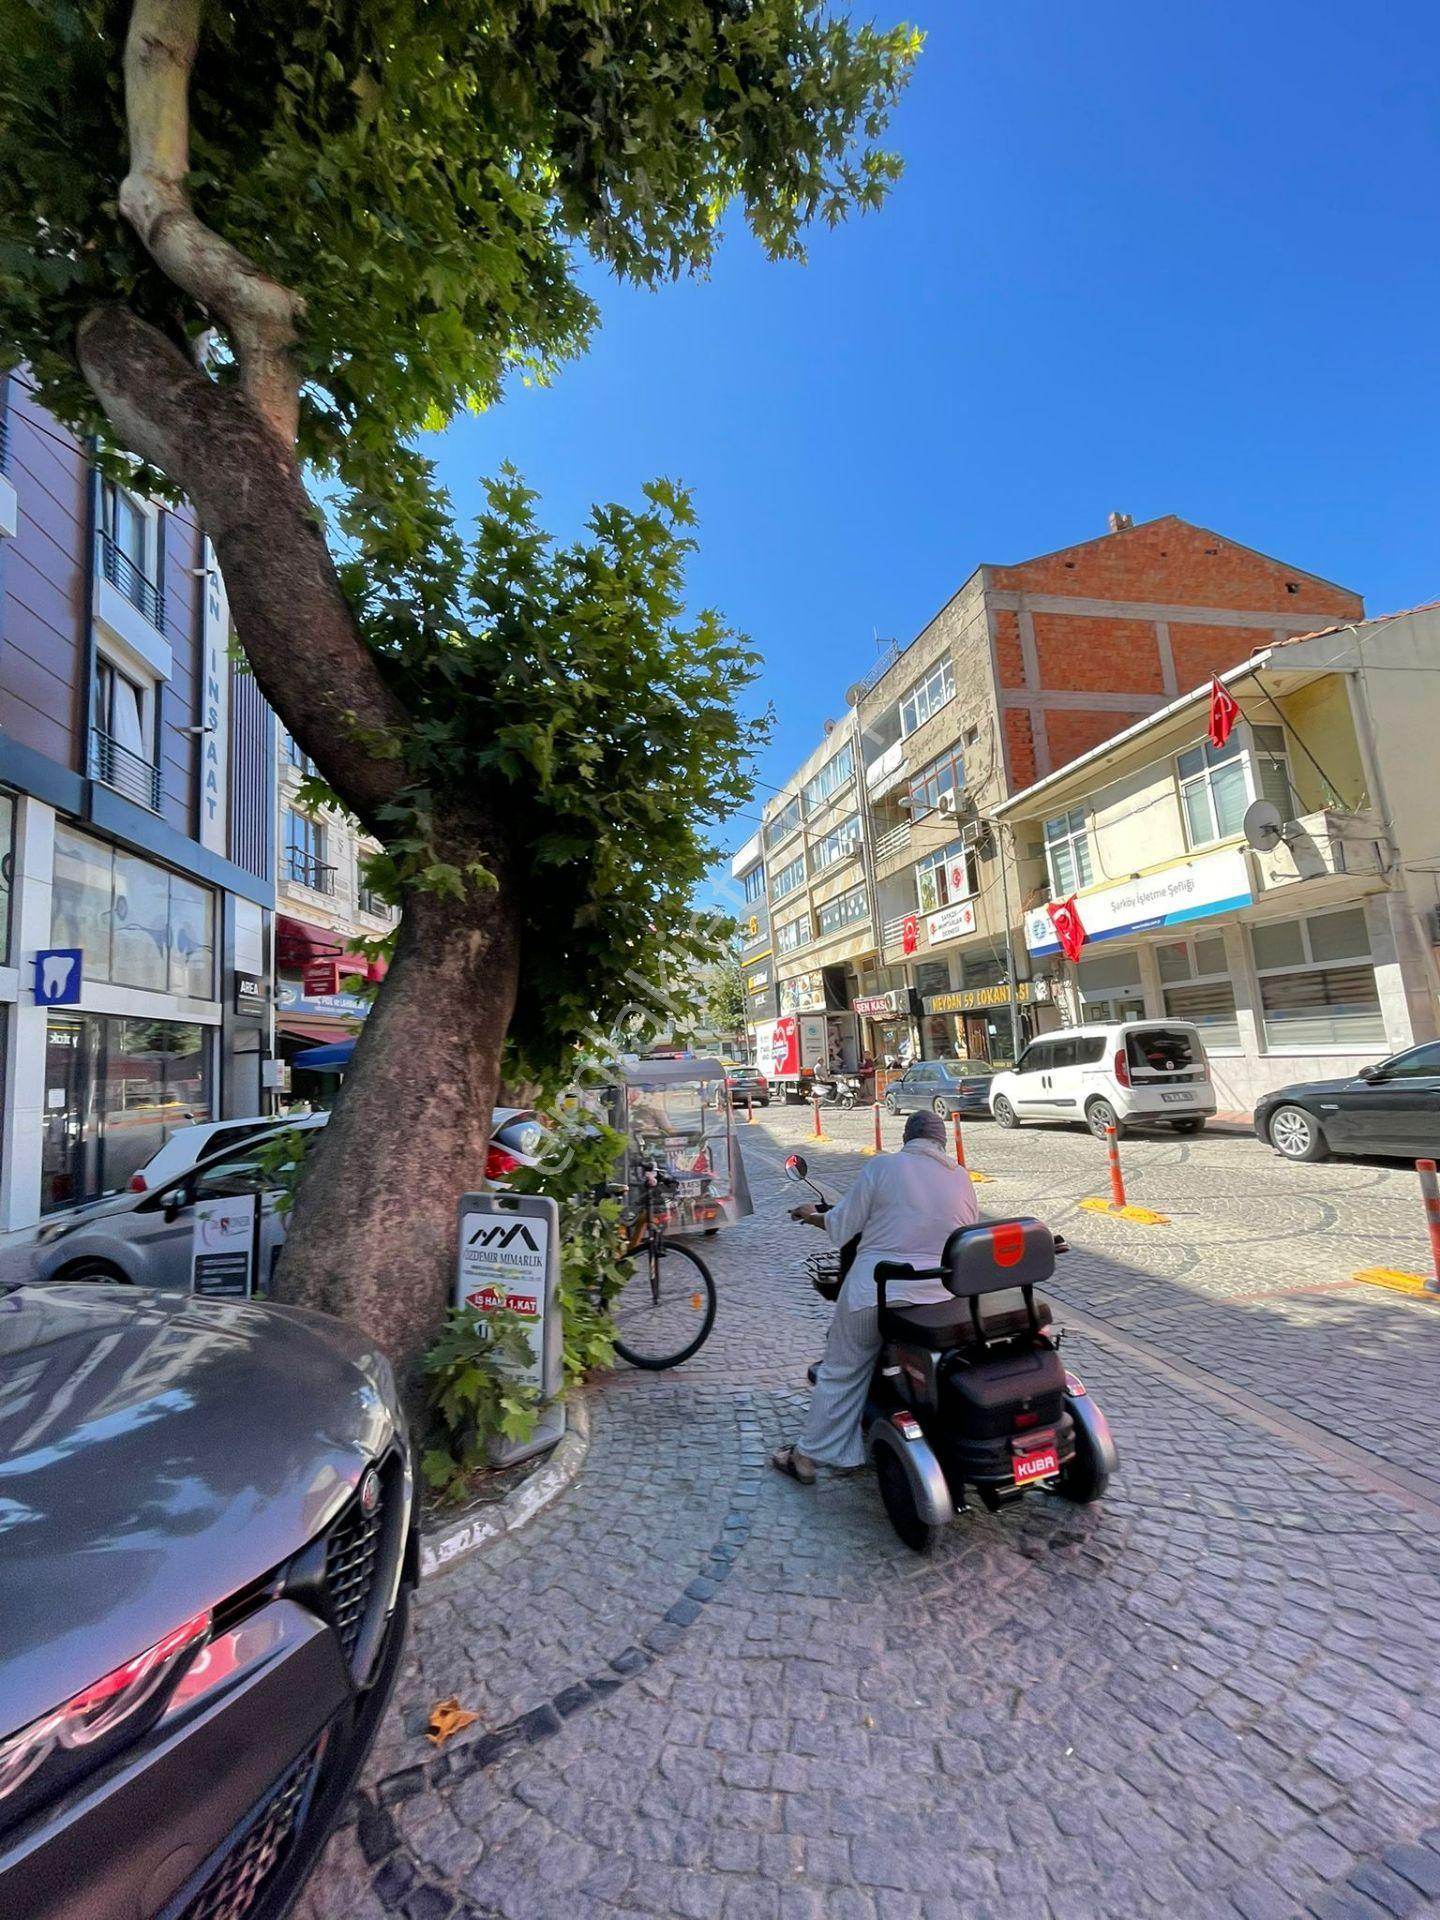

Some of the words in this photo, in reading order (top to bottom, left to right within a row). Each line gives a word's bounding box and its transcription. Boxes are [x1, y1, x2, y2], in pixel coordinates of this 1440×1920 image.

[240, 980, 259, 995] AREA
[932, 993, 962, 1012] MEYDAN
[964, 992, 974, 1008] 59
[977, 983, 1030, 1006] LOKANTSI
[508, 1299, 537, 1311] 1.KAT
[1017, 1455, 1055, 1477] KUBA
